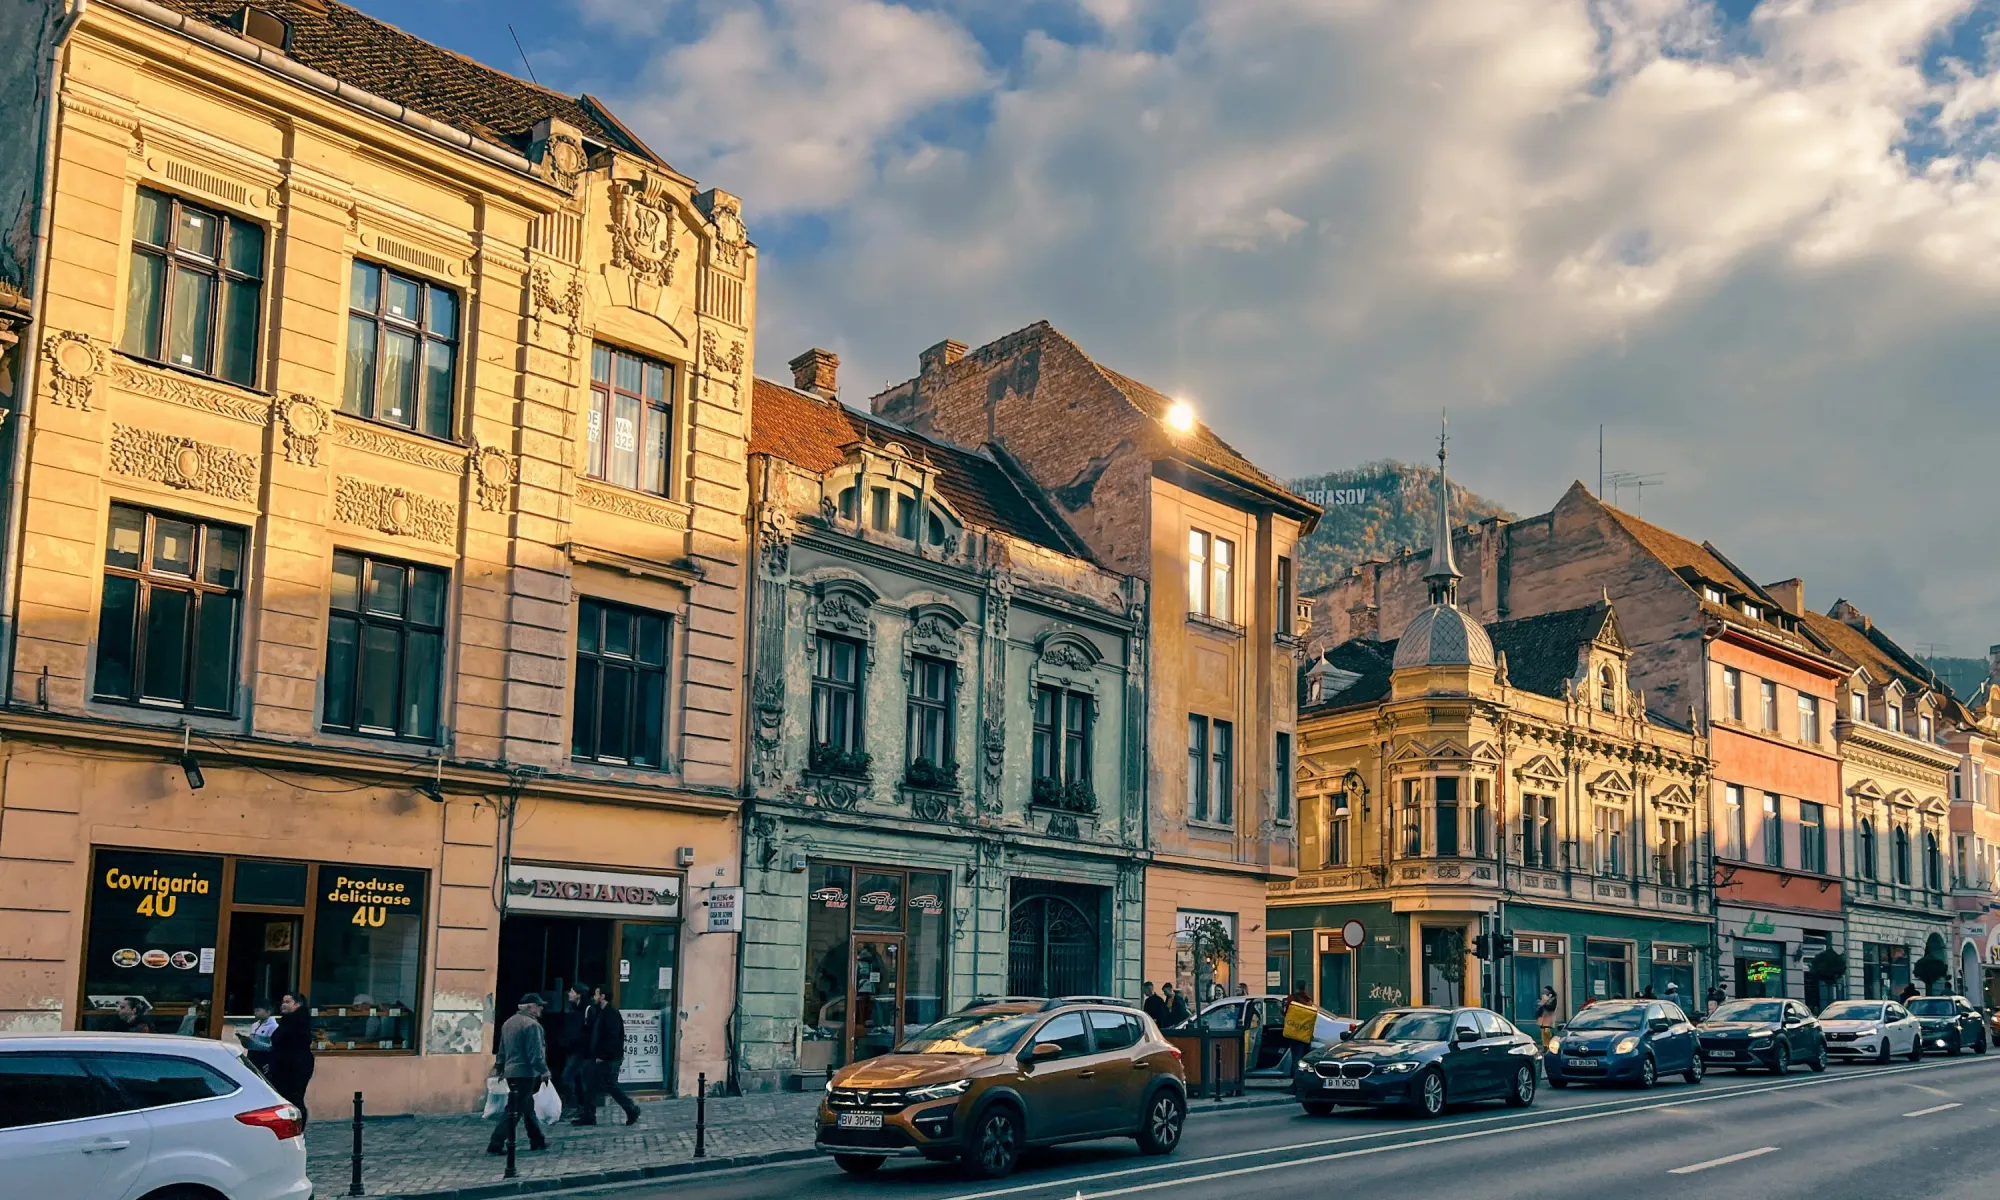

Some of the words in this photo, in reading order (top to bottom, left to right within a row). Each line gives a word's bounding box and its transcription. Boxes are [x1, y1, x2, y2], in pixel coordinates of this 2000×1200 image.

[616, 434, 633, 450] 325
[1305, 488, 1366, 505] BRASOV
[106, 868, 209, 897] Covrigaria
[337, 876, 405, 892] Produse
[328, 889, 411, 905] delicioase
[533, 879, 656, 905] EXCHANGE
[136, 893, 177, 917] 4U
[351, 905, 387, 928] 4U
[841, 1115, 853, 1125] BV
